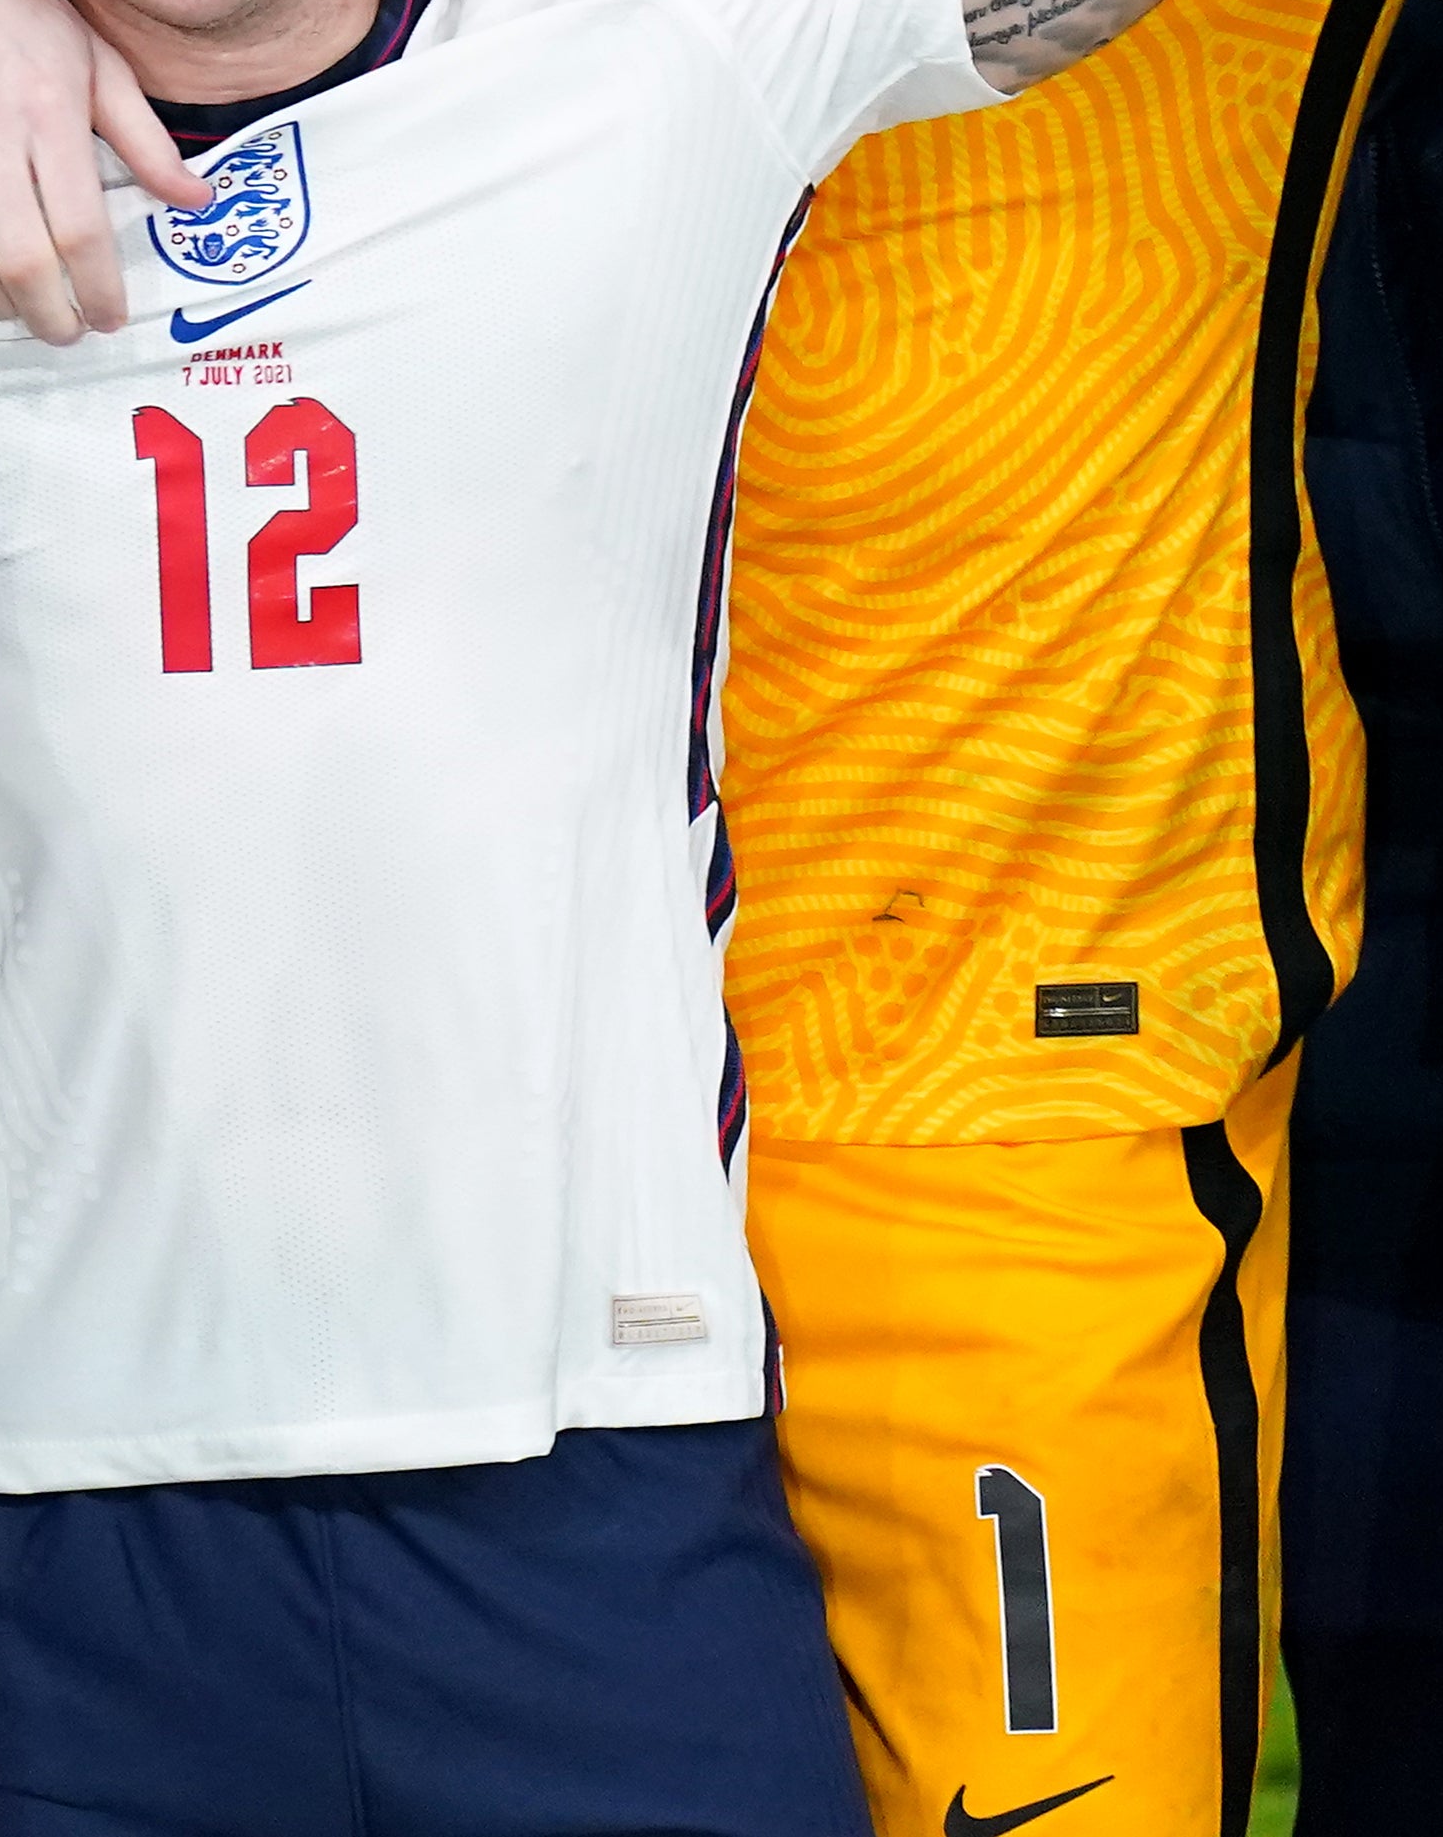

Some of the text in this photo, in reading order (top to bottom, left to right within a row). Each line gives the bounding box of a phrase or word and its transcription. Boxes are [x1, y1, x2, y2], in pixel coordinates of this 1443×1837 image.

[182, 364, 292, 386] 7 JULY 2021
[190, 342, 283, 363] DENMARK
[132, 396, 362, 673] 12
[974, 1463, 1059, 1735] 1
